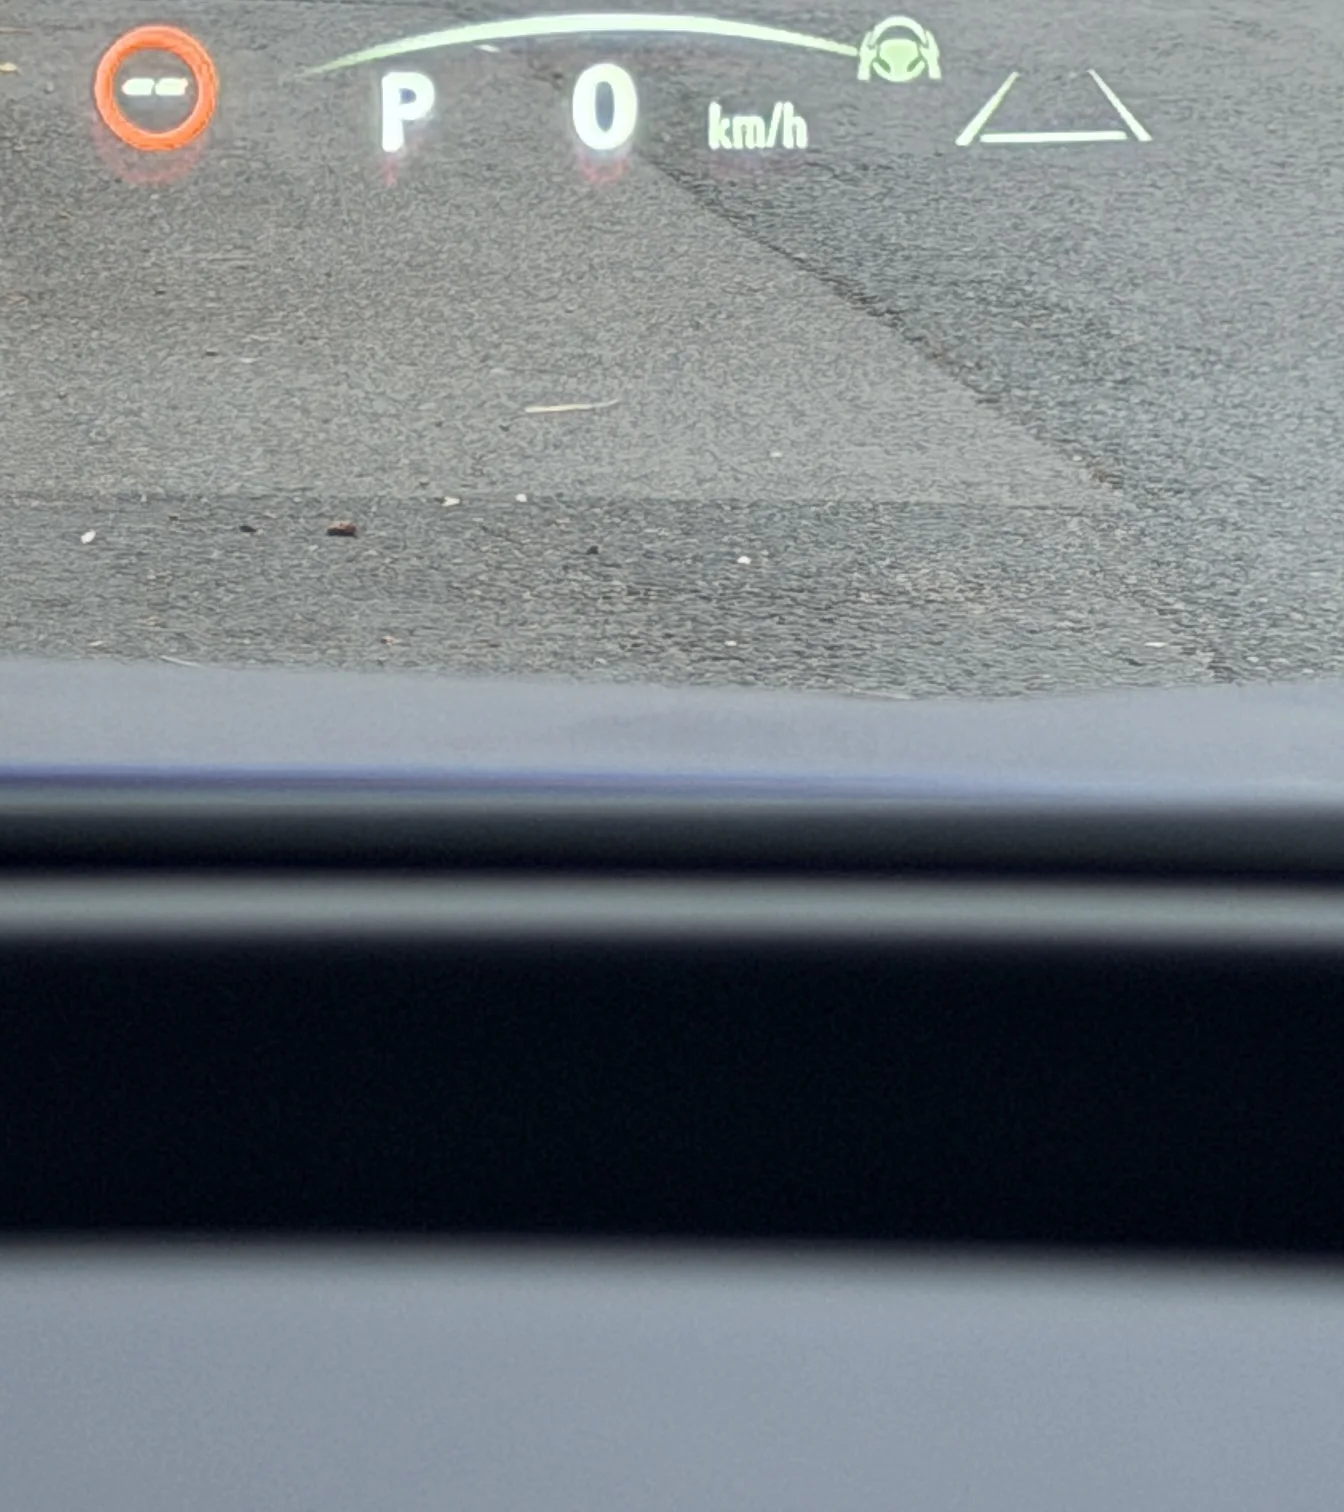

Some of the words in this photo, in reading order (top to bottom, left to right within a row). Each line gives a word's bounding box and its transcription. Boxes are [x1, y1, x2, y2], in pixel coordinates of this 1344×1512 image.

[381, 71, 435, 153] P
[572, 62, 638, 150] 0
[708, 100, 808, 150] km/h
